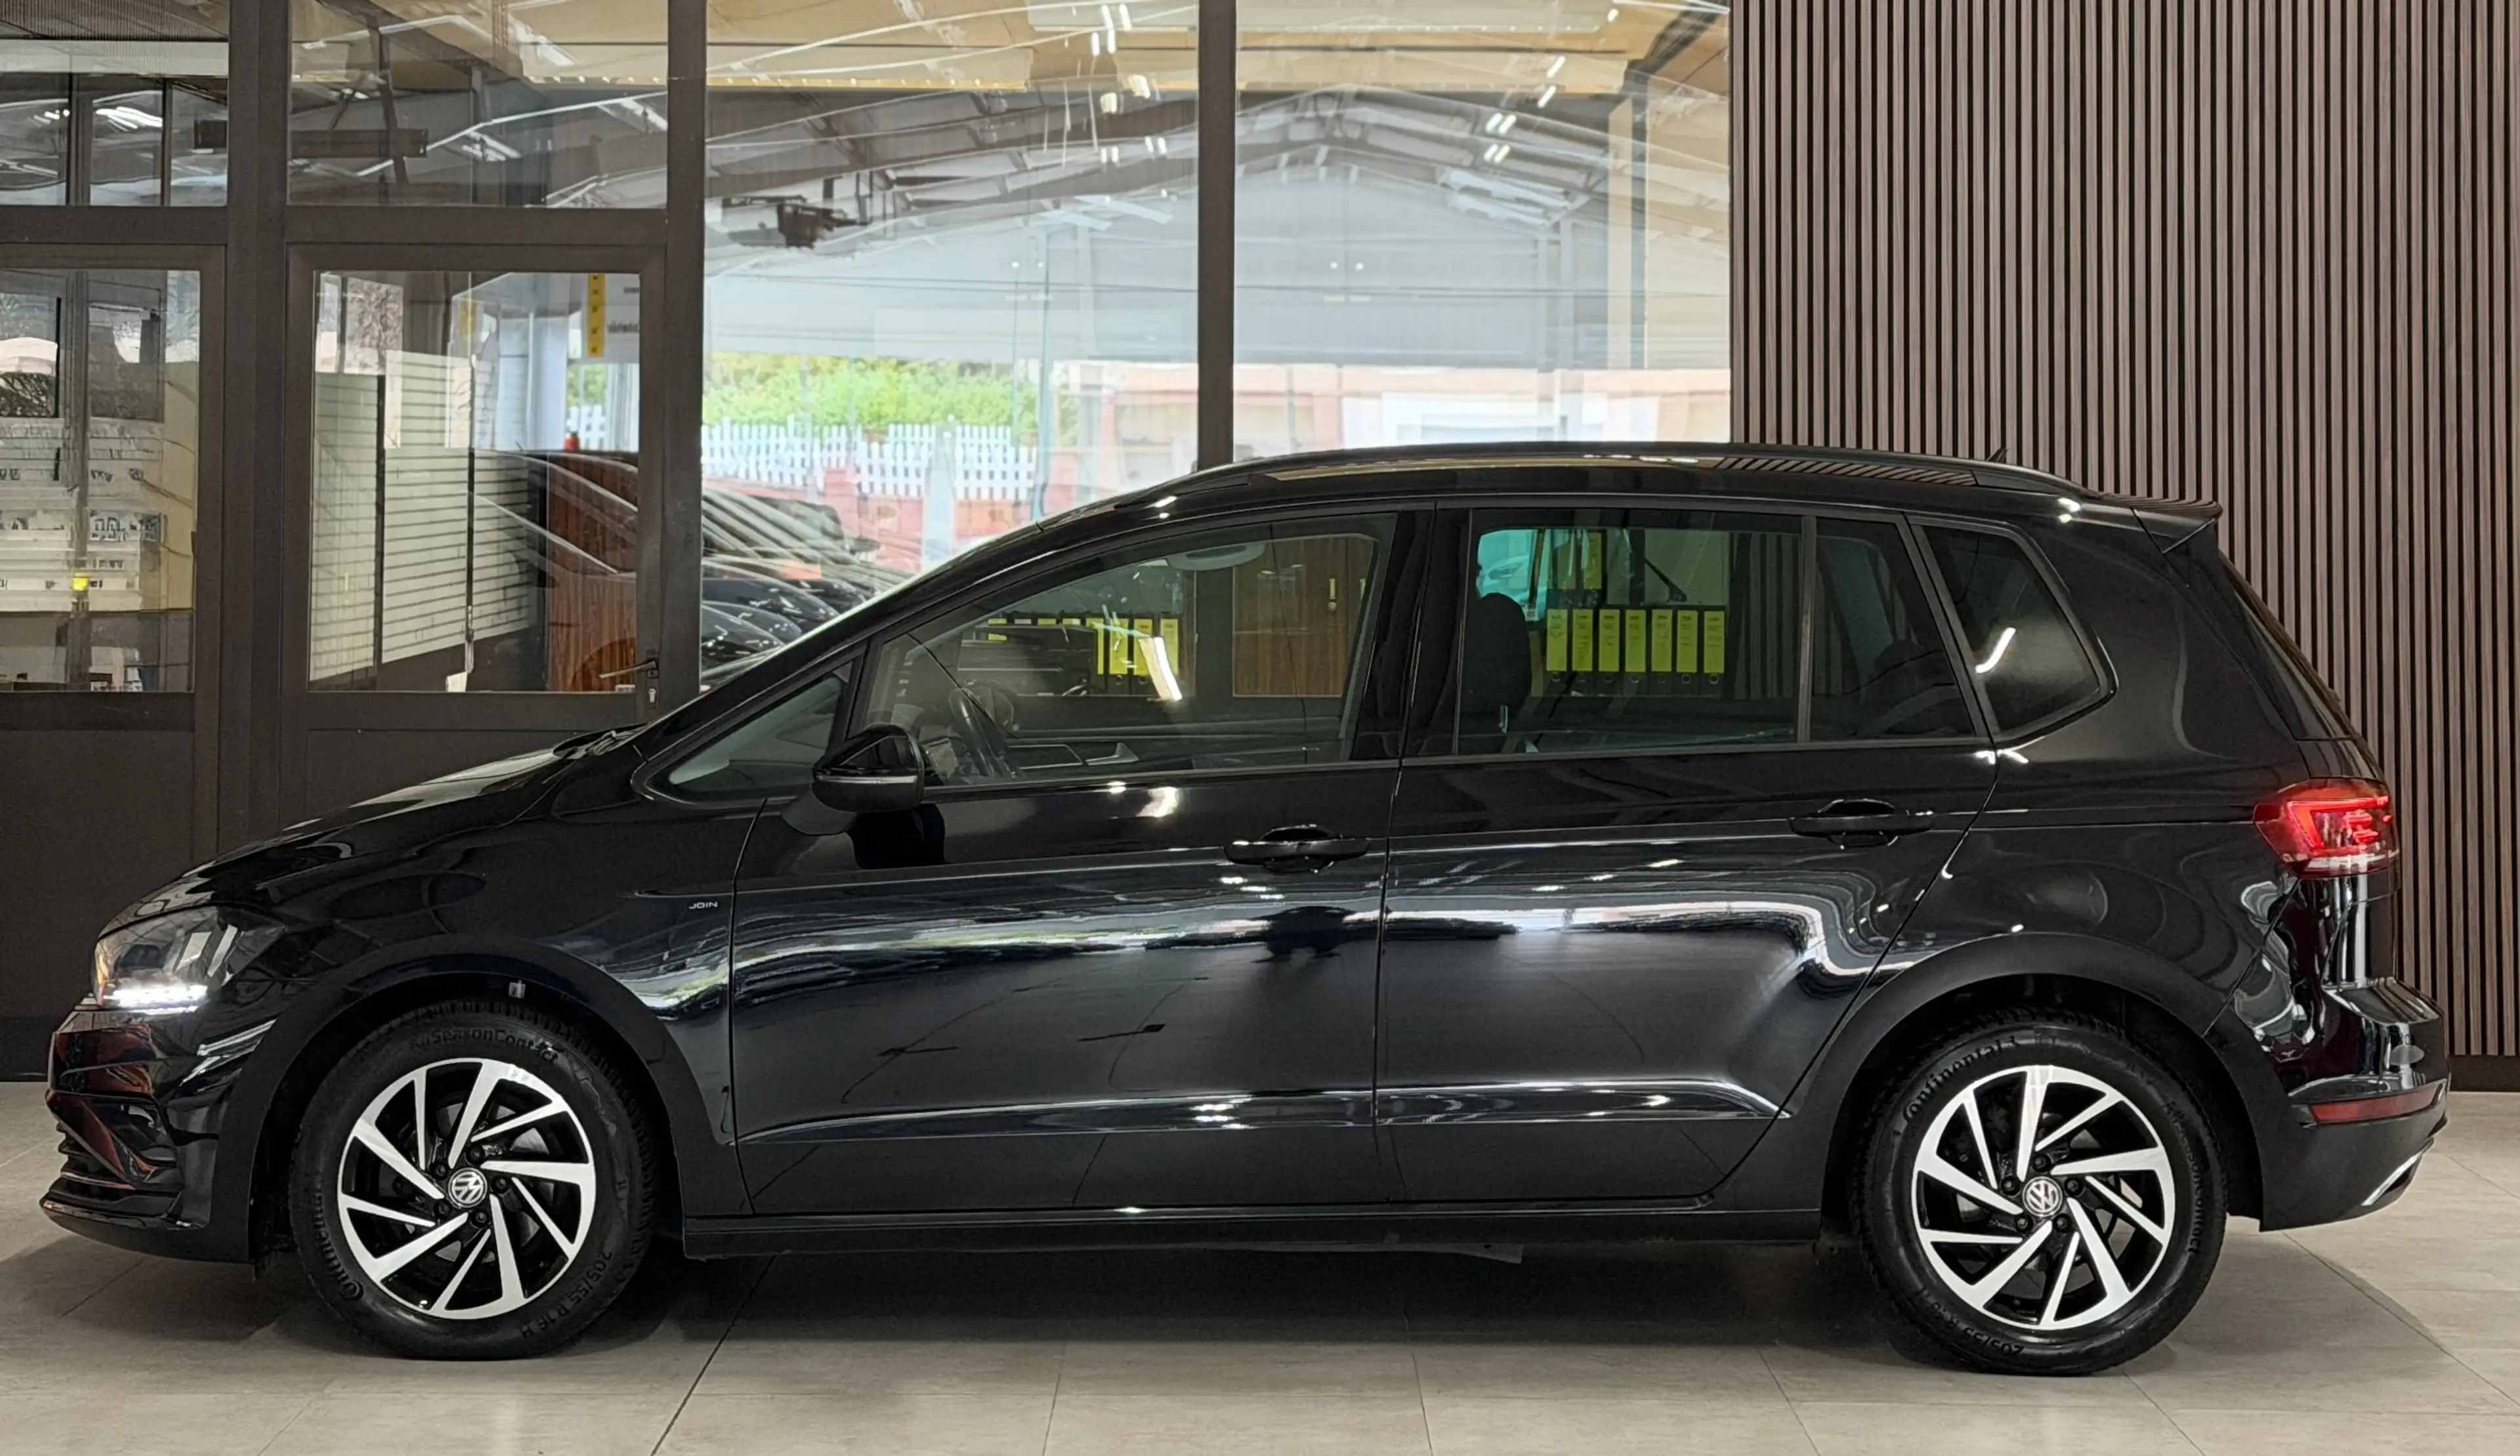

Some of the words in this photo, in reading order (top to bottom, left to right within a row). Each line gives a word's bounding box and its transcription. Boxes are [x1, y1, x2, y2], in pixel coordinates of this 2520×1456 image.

[688, 901, 719, 910] JOIN
[1902, 1038, 2004, 1123] Continental
[450, 1169, 486, 1206] VW
[2024, 1178, 2061, 1215] VW
[568, 1251, 613, 1304] 205/55
[537, 1314, 556, 1331] 16
[558, 1302, 570, 1316] R
[1965, 1327, 2024, 1357] 205/55
